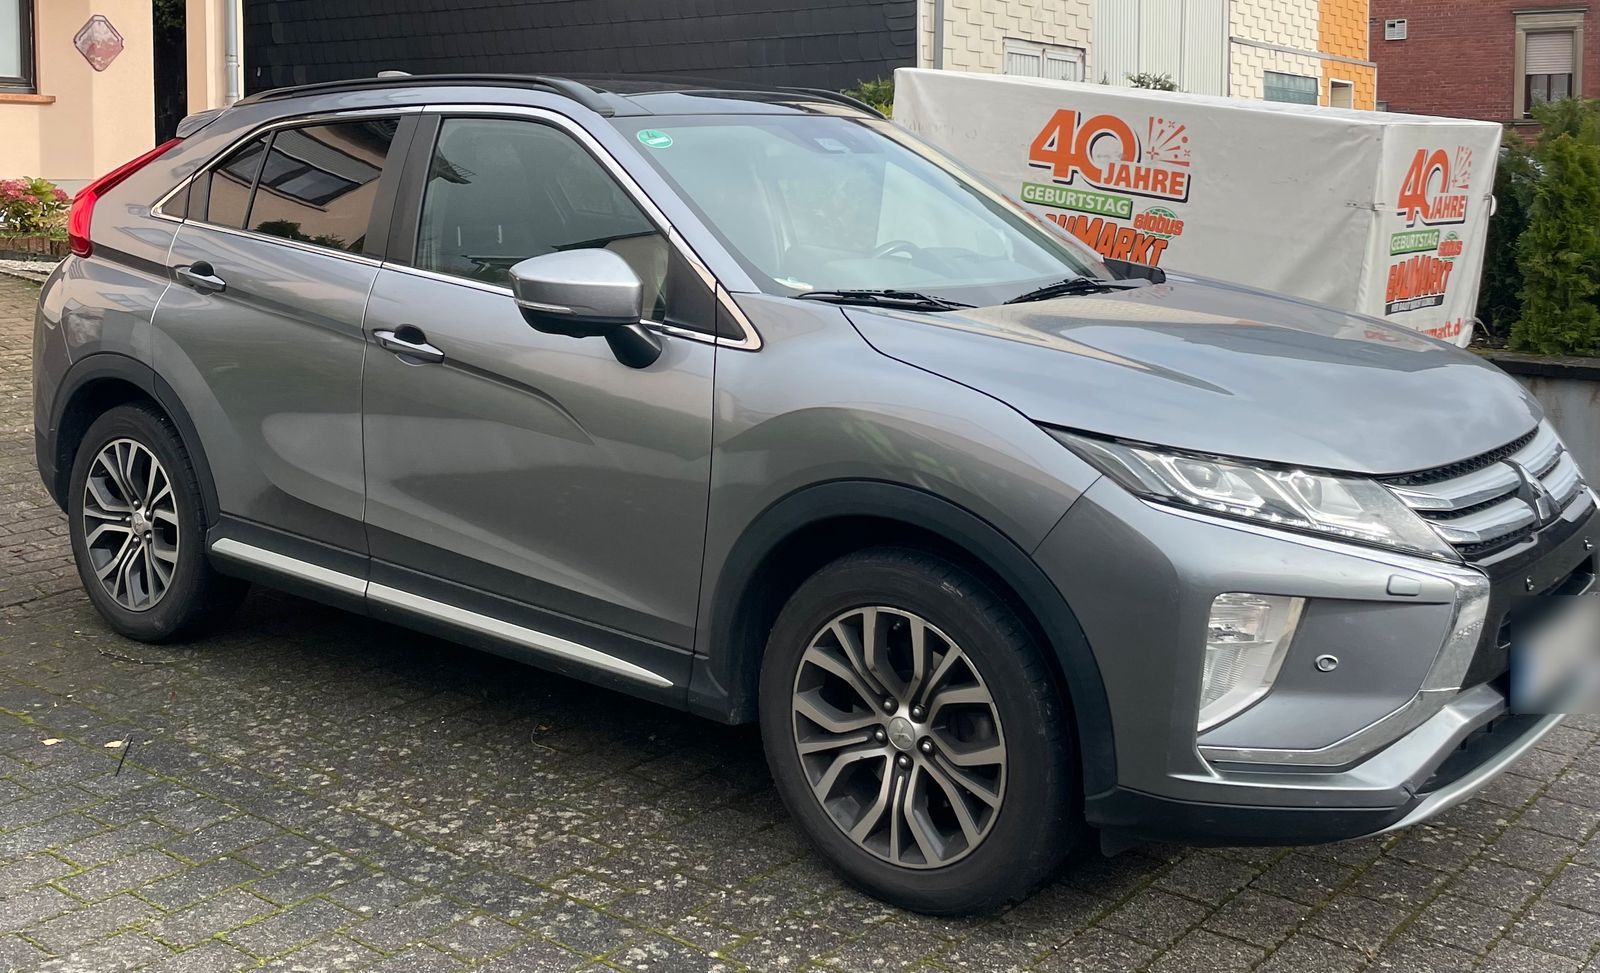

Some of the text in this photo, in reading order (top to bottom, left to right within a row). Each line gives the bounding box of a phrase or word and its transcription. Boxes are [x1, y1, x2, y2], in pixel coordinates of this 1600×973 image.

[1029, 109, 1136, 184] 40
[1103, 162, 1186, 196] JAHRE
[1397, 149, 1449, 221] 40
[1023, 185, 1130, 215] GEBURTSTAG
[1429, 195, 1467, 220] JAHRE
[1391, 231, 1439, 251] GEBURTSTAG
[1385, 254, 1454, 304] BAUMARKT
